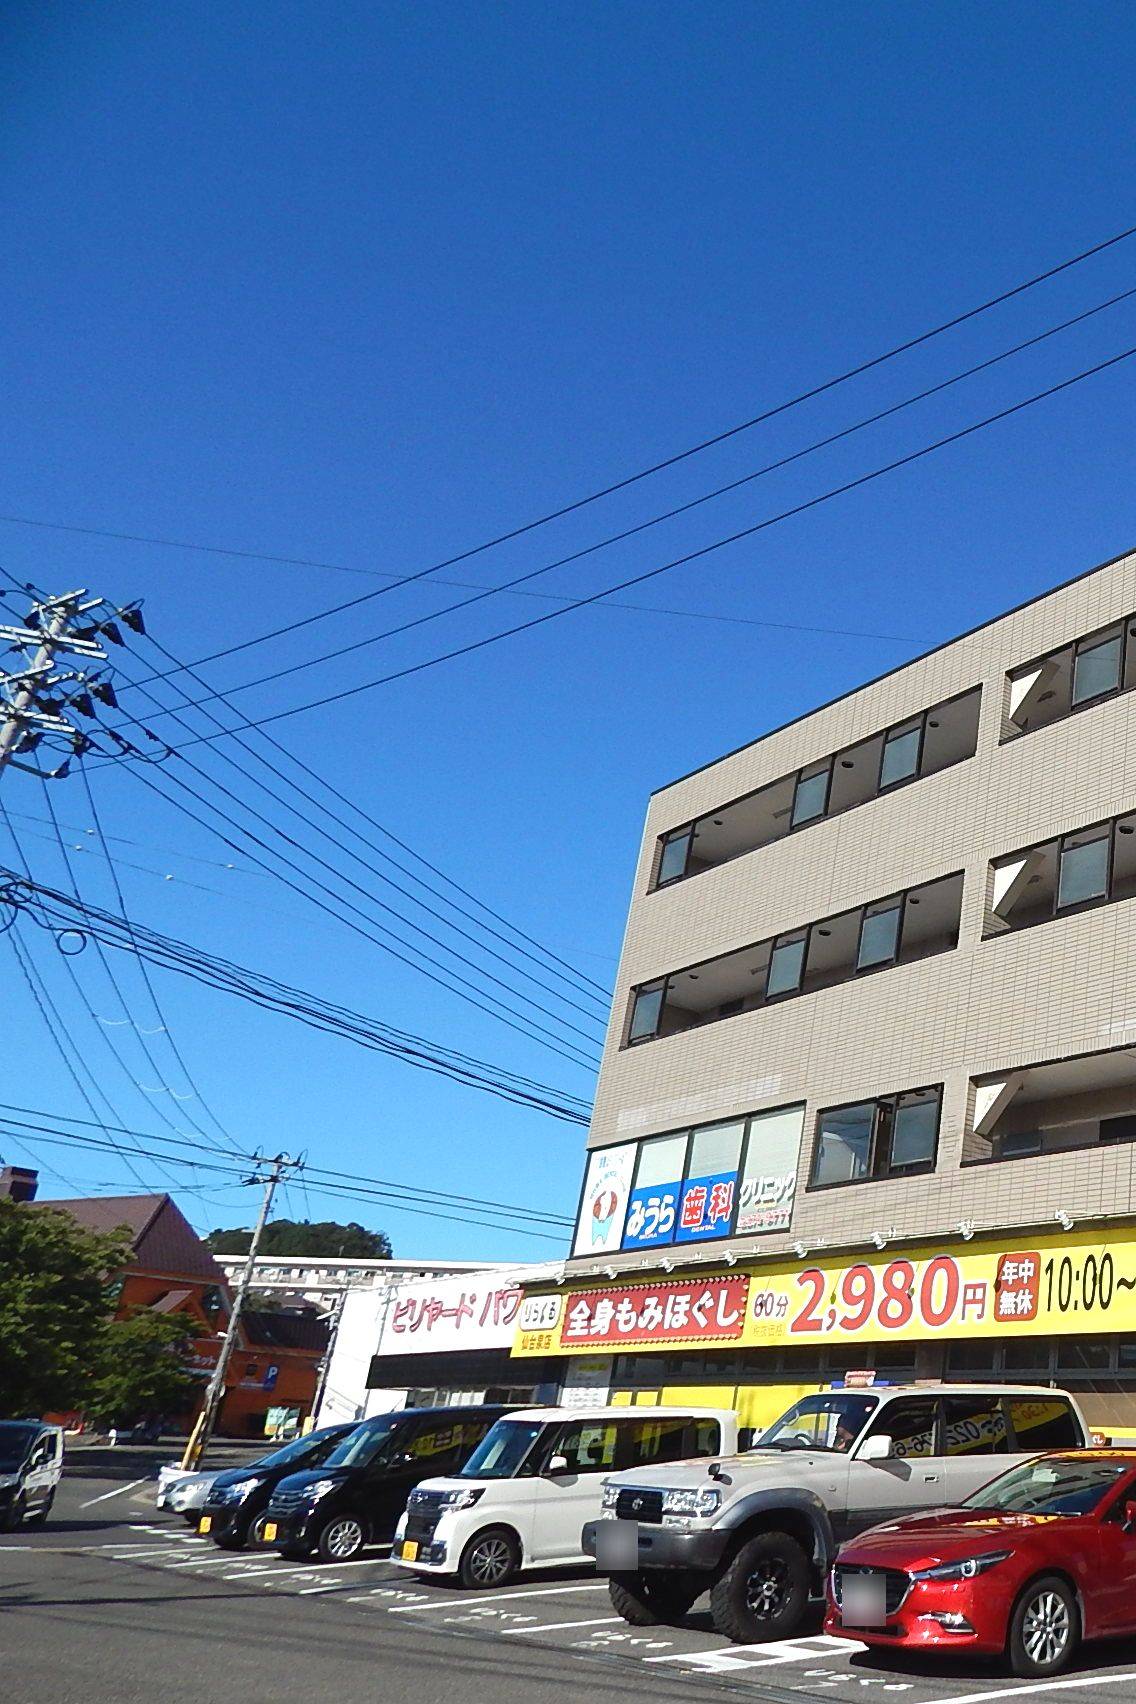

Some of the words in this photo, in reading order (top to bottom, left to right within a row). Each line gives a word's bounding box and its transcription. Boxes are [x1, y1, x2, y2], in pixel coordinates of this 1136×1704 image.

[626, 1194, 675, 1237] みうら
[681, 1180, 735, 1228] 歯科
[738, 1170, 797, 1208] クリニック
[1000, 1258, 1035, 1285] 年中
[525, 1301, 556, 1324] りらくる
[566, 1289, 740, 1337] 全身もみほぐし
[754, 1292, 789, 1319] 60分
[998, 1289, 1034, 1316] 無休
